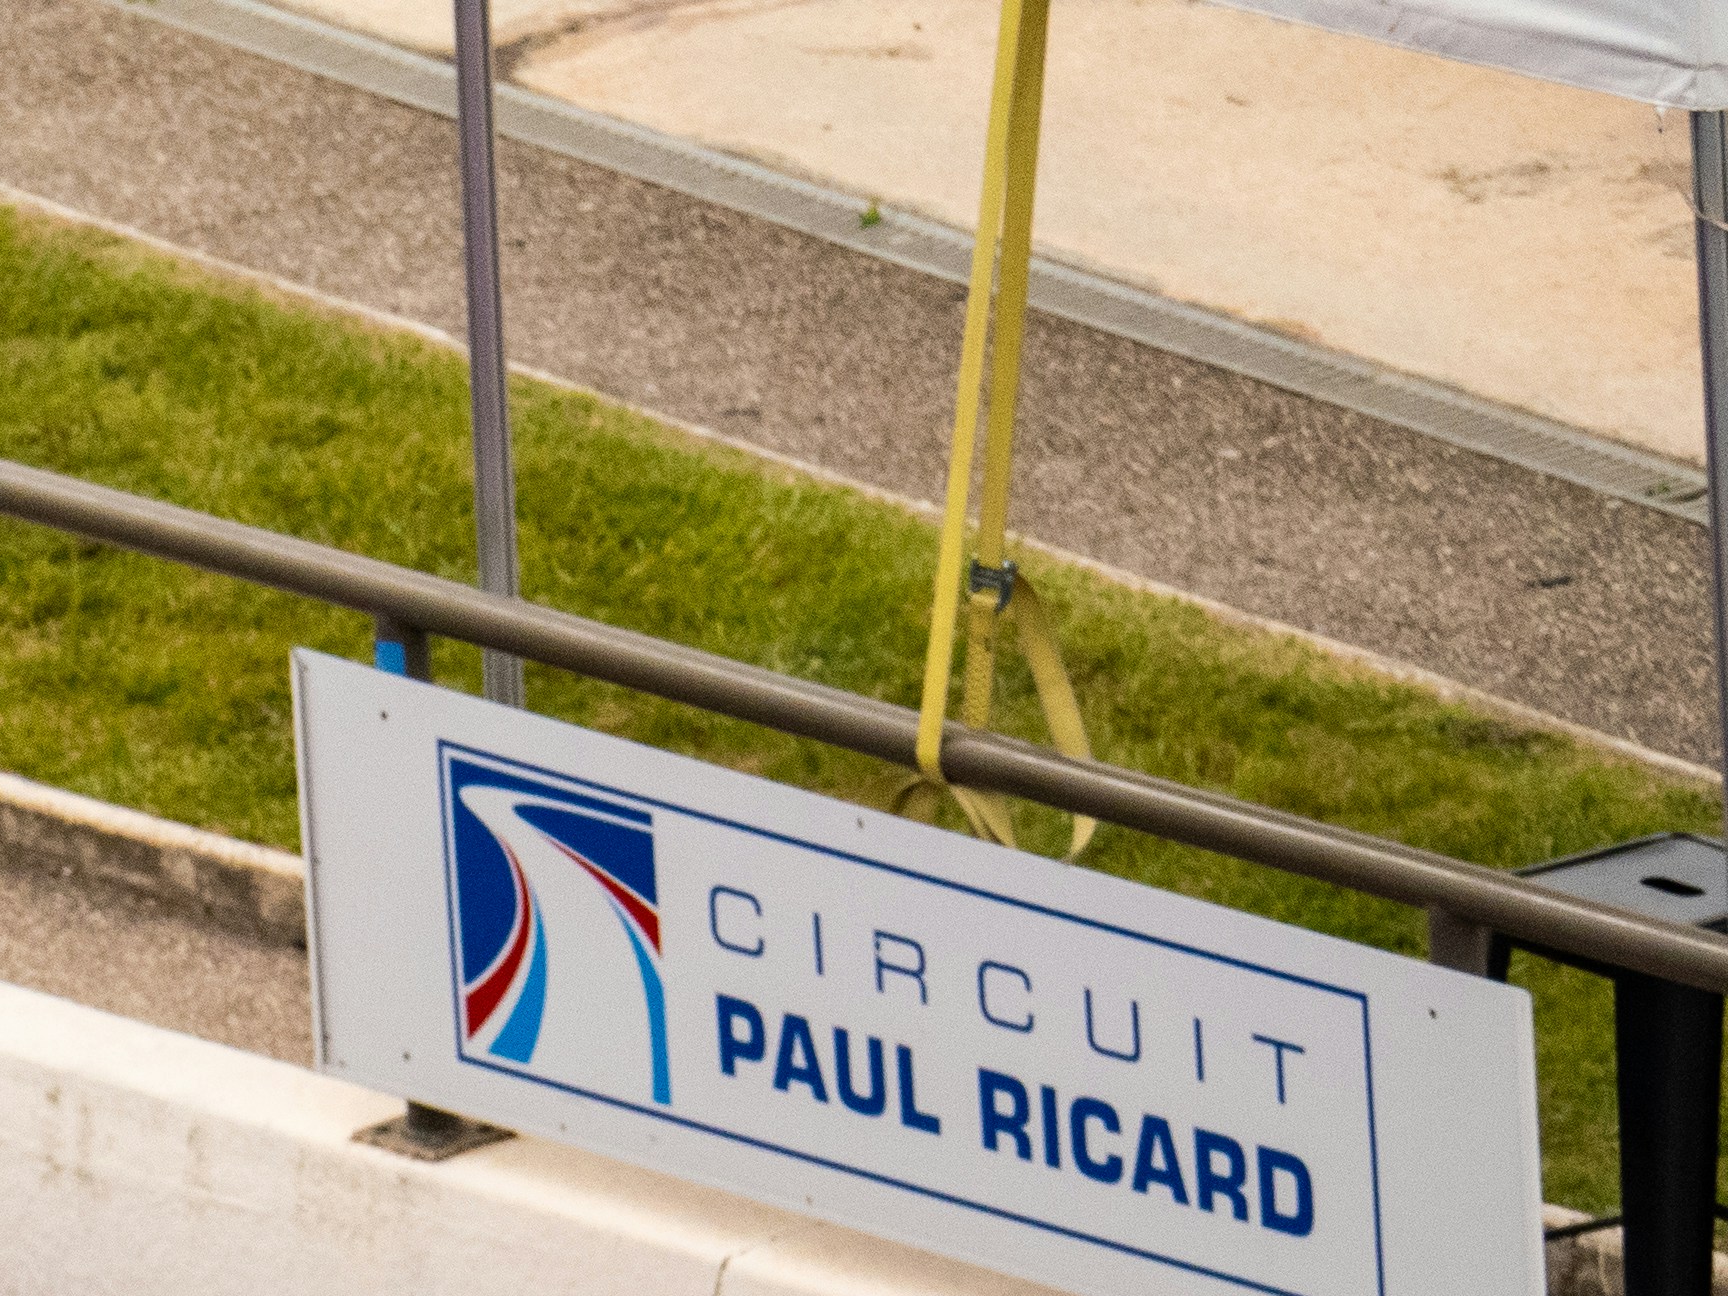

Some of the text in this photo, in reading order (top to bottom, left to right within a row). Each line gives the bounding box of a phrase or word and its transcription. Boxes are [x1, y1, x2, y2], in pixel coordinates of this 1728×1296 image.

[708, 883, 1307, 1105] CIRCUIT
[715, 992, 1315, 1239] PAUL RICARD
